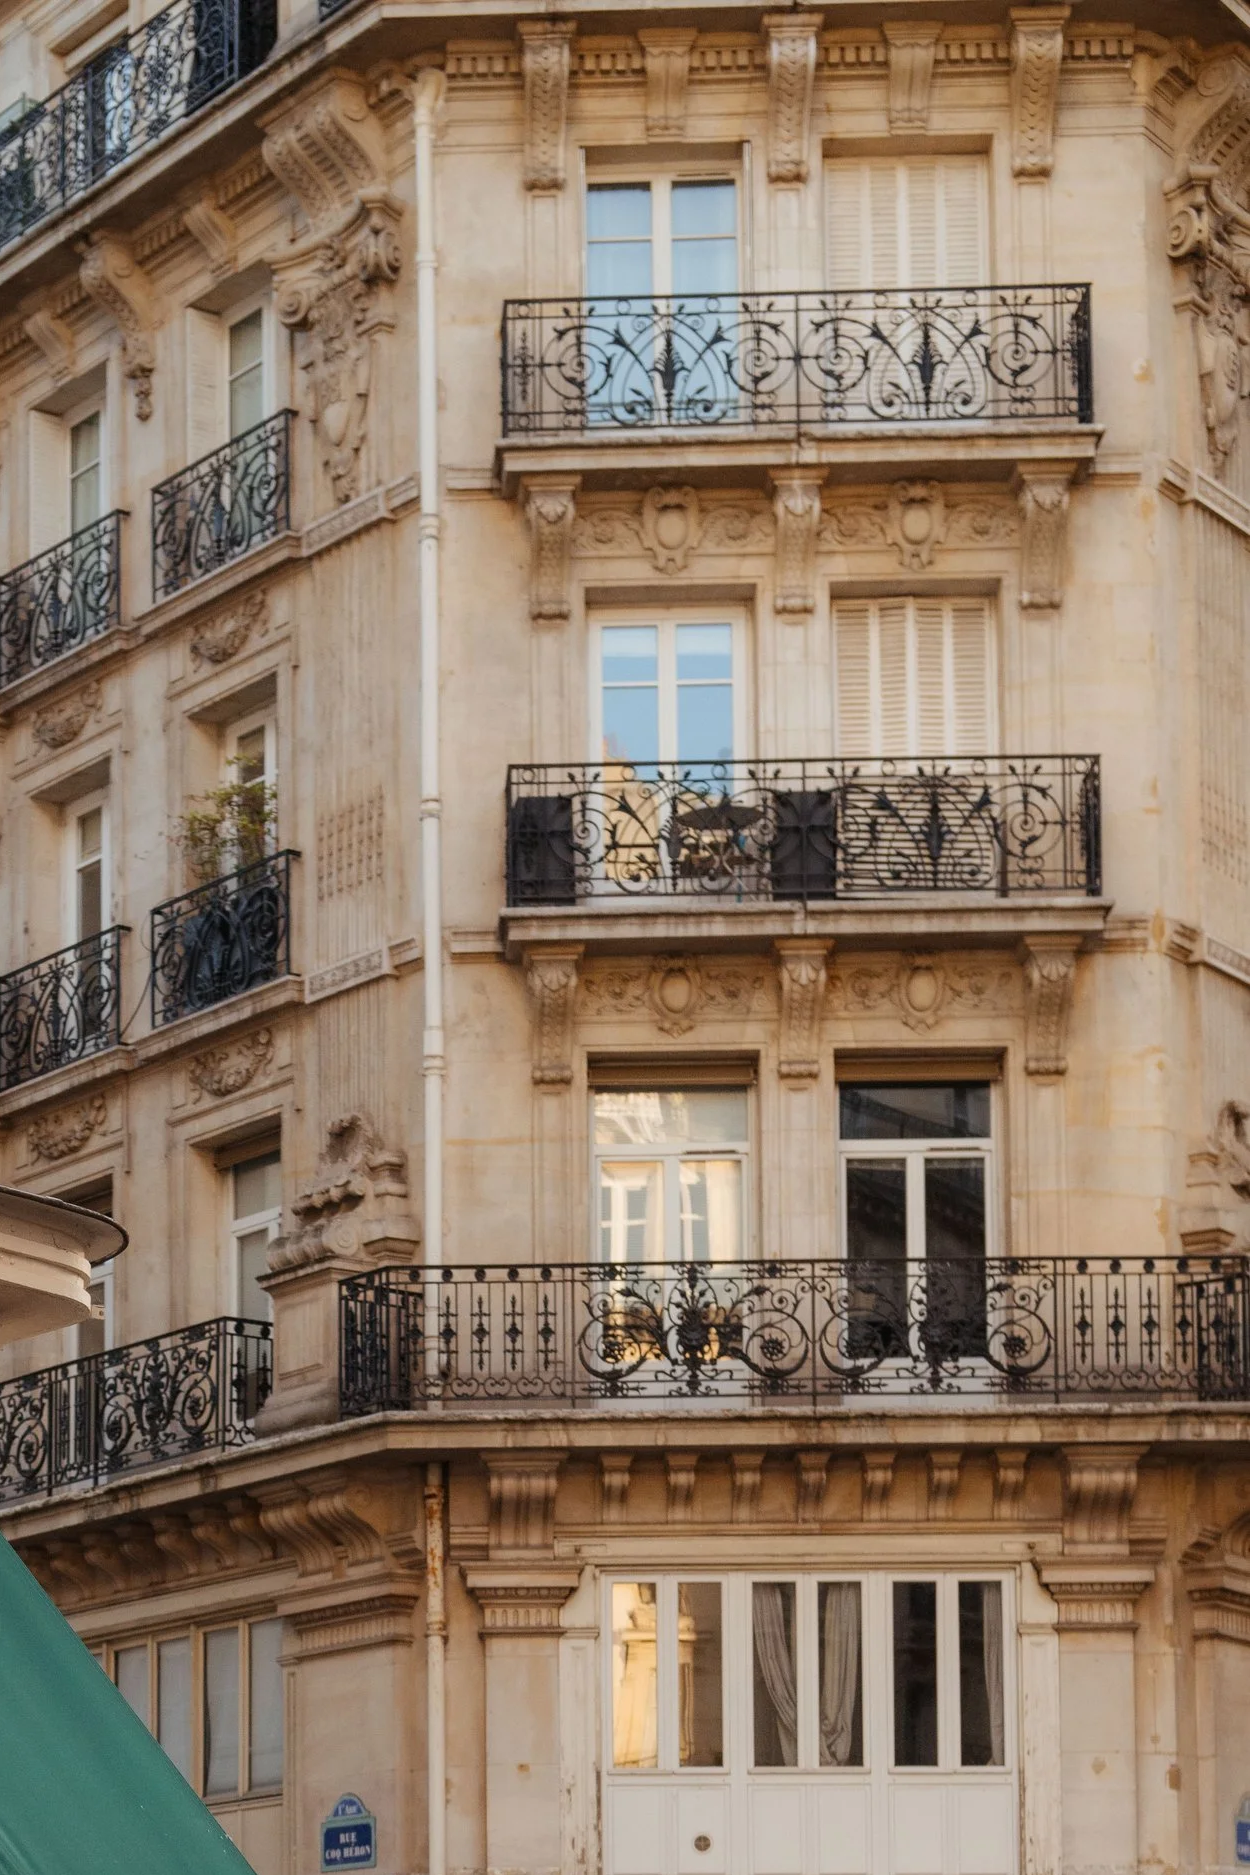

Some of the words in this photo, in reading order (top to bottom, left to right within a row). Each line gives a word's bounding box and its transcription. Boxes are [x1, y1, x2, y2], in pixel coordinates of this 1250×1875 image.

[339, 1832, 357, 1844] RUE
[325, 1848, 341, 1861] COQ
[343, 1843, 371, 1858] HÉRON
